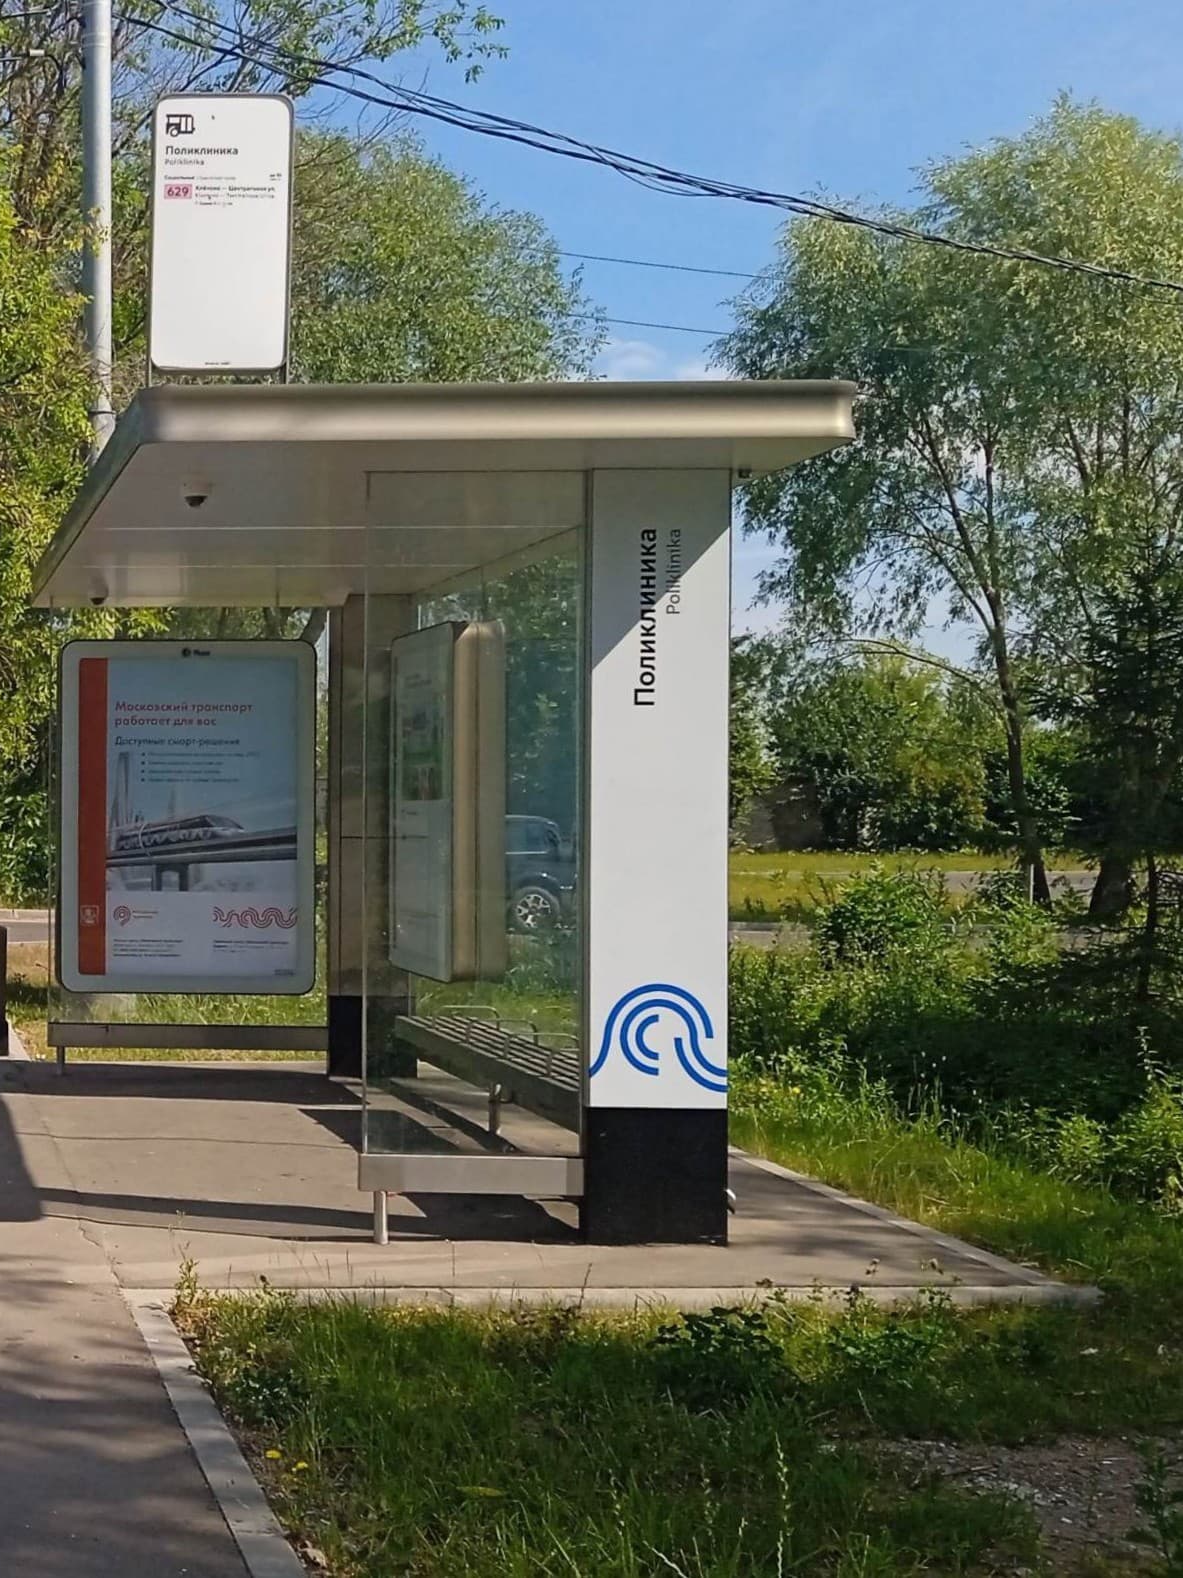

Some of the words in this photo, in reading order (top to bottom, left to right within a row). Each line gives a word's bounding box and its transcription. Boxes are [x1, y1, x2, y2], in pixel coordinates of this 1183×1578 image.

[165, 145, 239, 156] Поликлиника
[167, 187, 189, 197] 629
[665, 528, 681, 615] Poliklinika
[632, 528, 657, 706] Поликлиника
[114, 701, 189, 712] Московский
[192, 704, 253, 714] транспорт
[114, 715, 171, 728] работает
[173, 717, 193, 727] для
[196, 717, 217, 726] вас
[114, 735, 166, 747] Доступные
